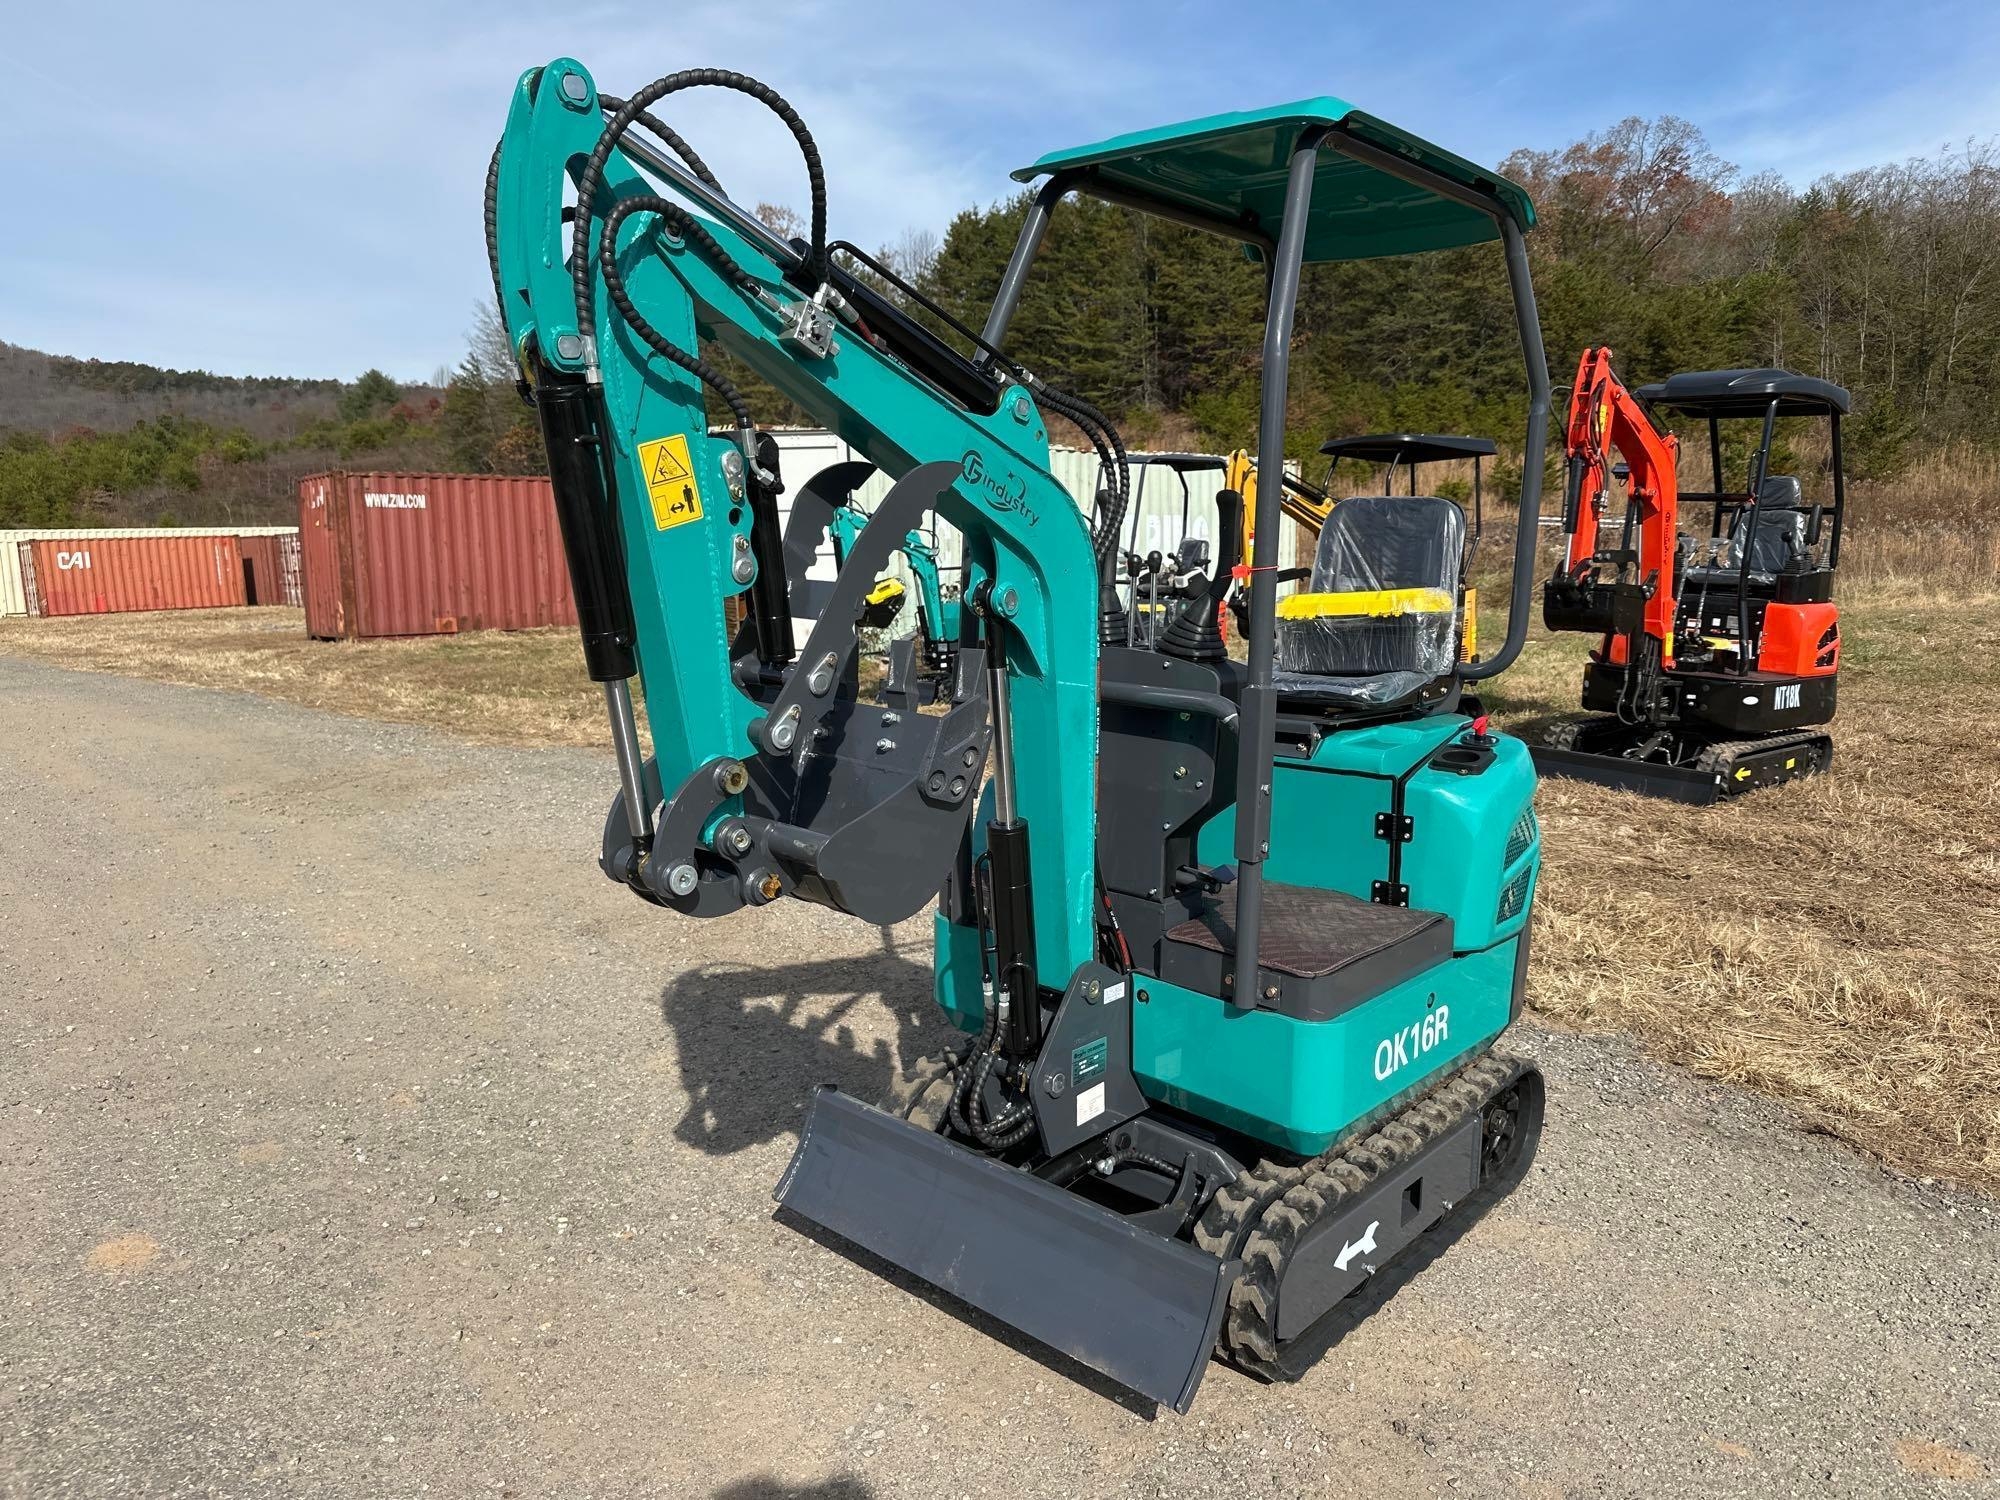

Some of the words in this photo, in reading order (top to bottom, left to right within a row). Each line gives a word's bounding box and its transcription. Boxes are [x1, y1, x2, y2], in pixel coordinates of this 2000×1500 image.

[364, 493, 426, 509] WWW.ZIM.COM
[56, 551, 91, 570] CAI
[1774, 683, 1801, 710] NT18K
[1374, 1005, 1449, 1081] QK16R
